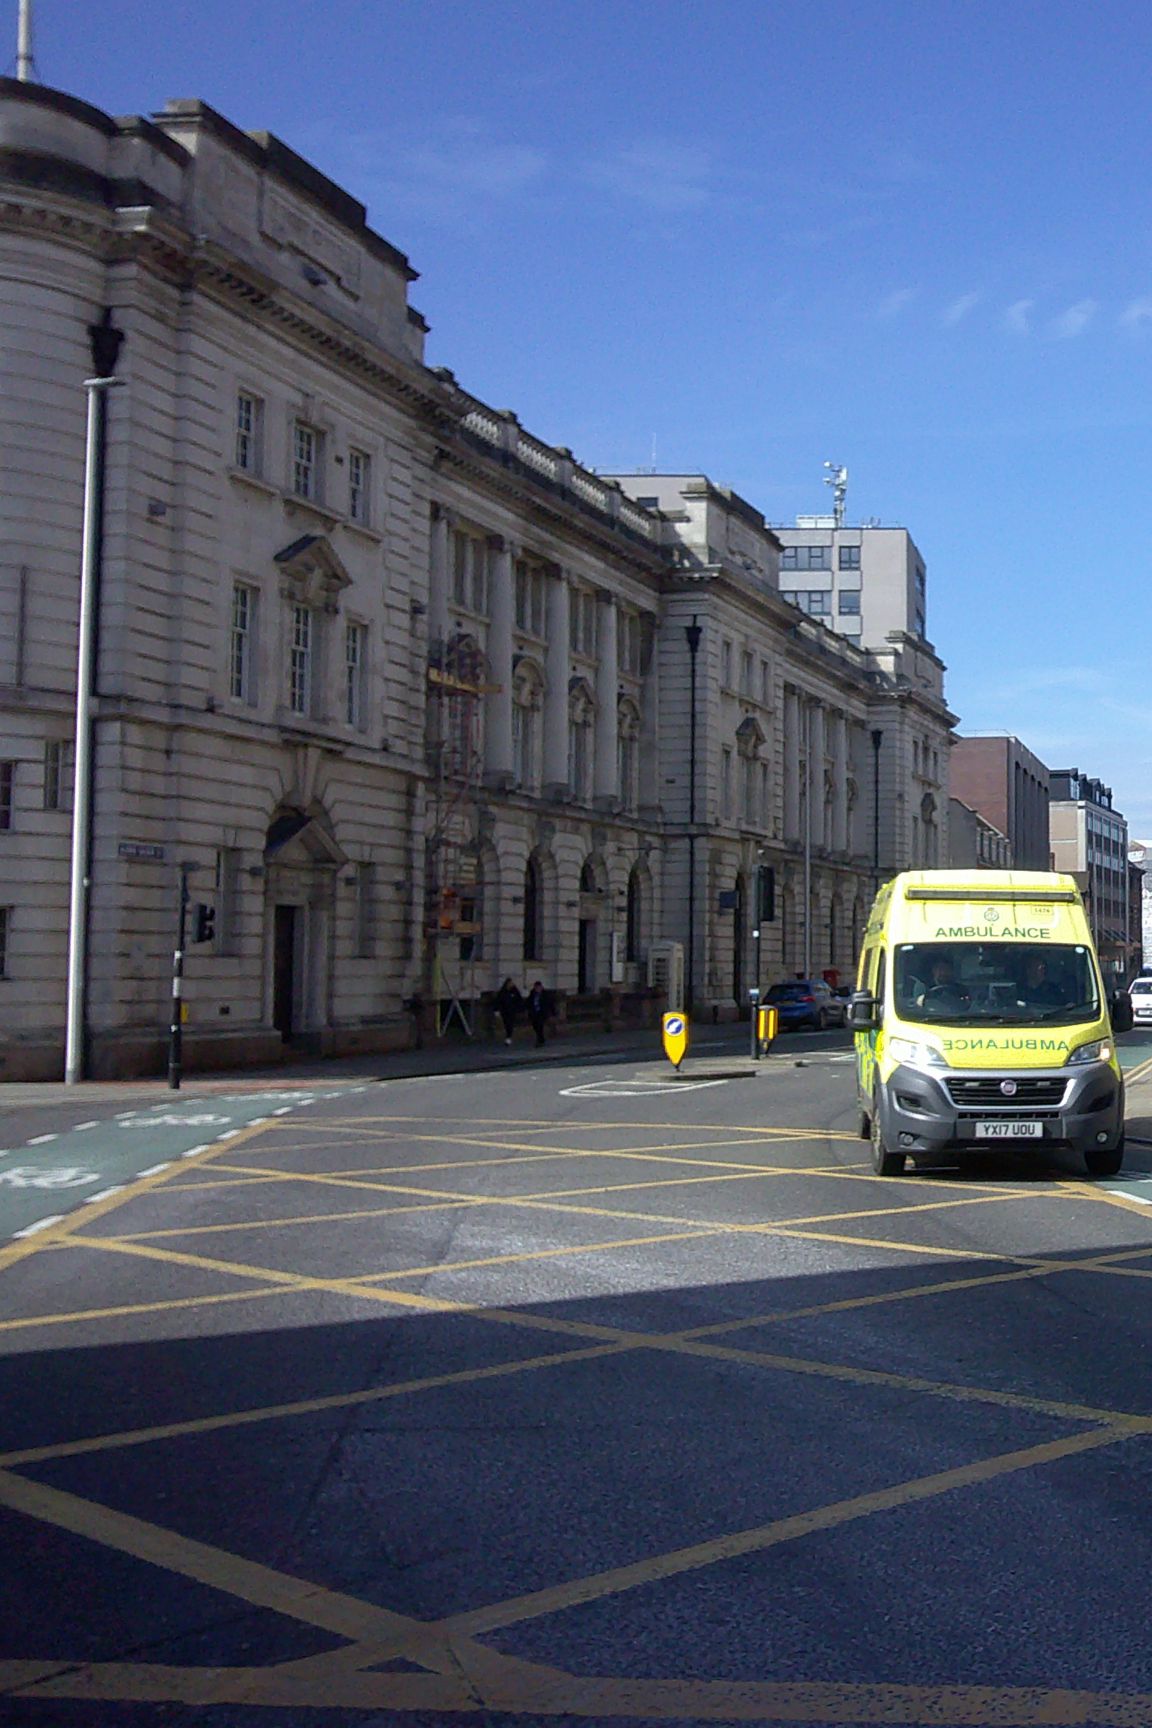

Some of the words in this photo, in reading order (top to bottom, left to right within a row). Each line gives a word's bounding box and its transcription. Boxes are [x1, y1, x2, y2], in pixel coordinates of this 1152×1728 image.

[935, 926, 1052, 939] AMBULANCE
[983, 1124, 1010, 1136] YX17
[1012, 1124, 1036, 1136] UOU
